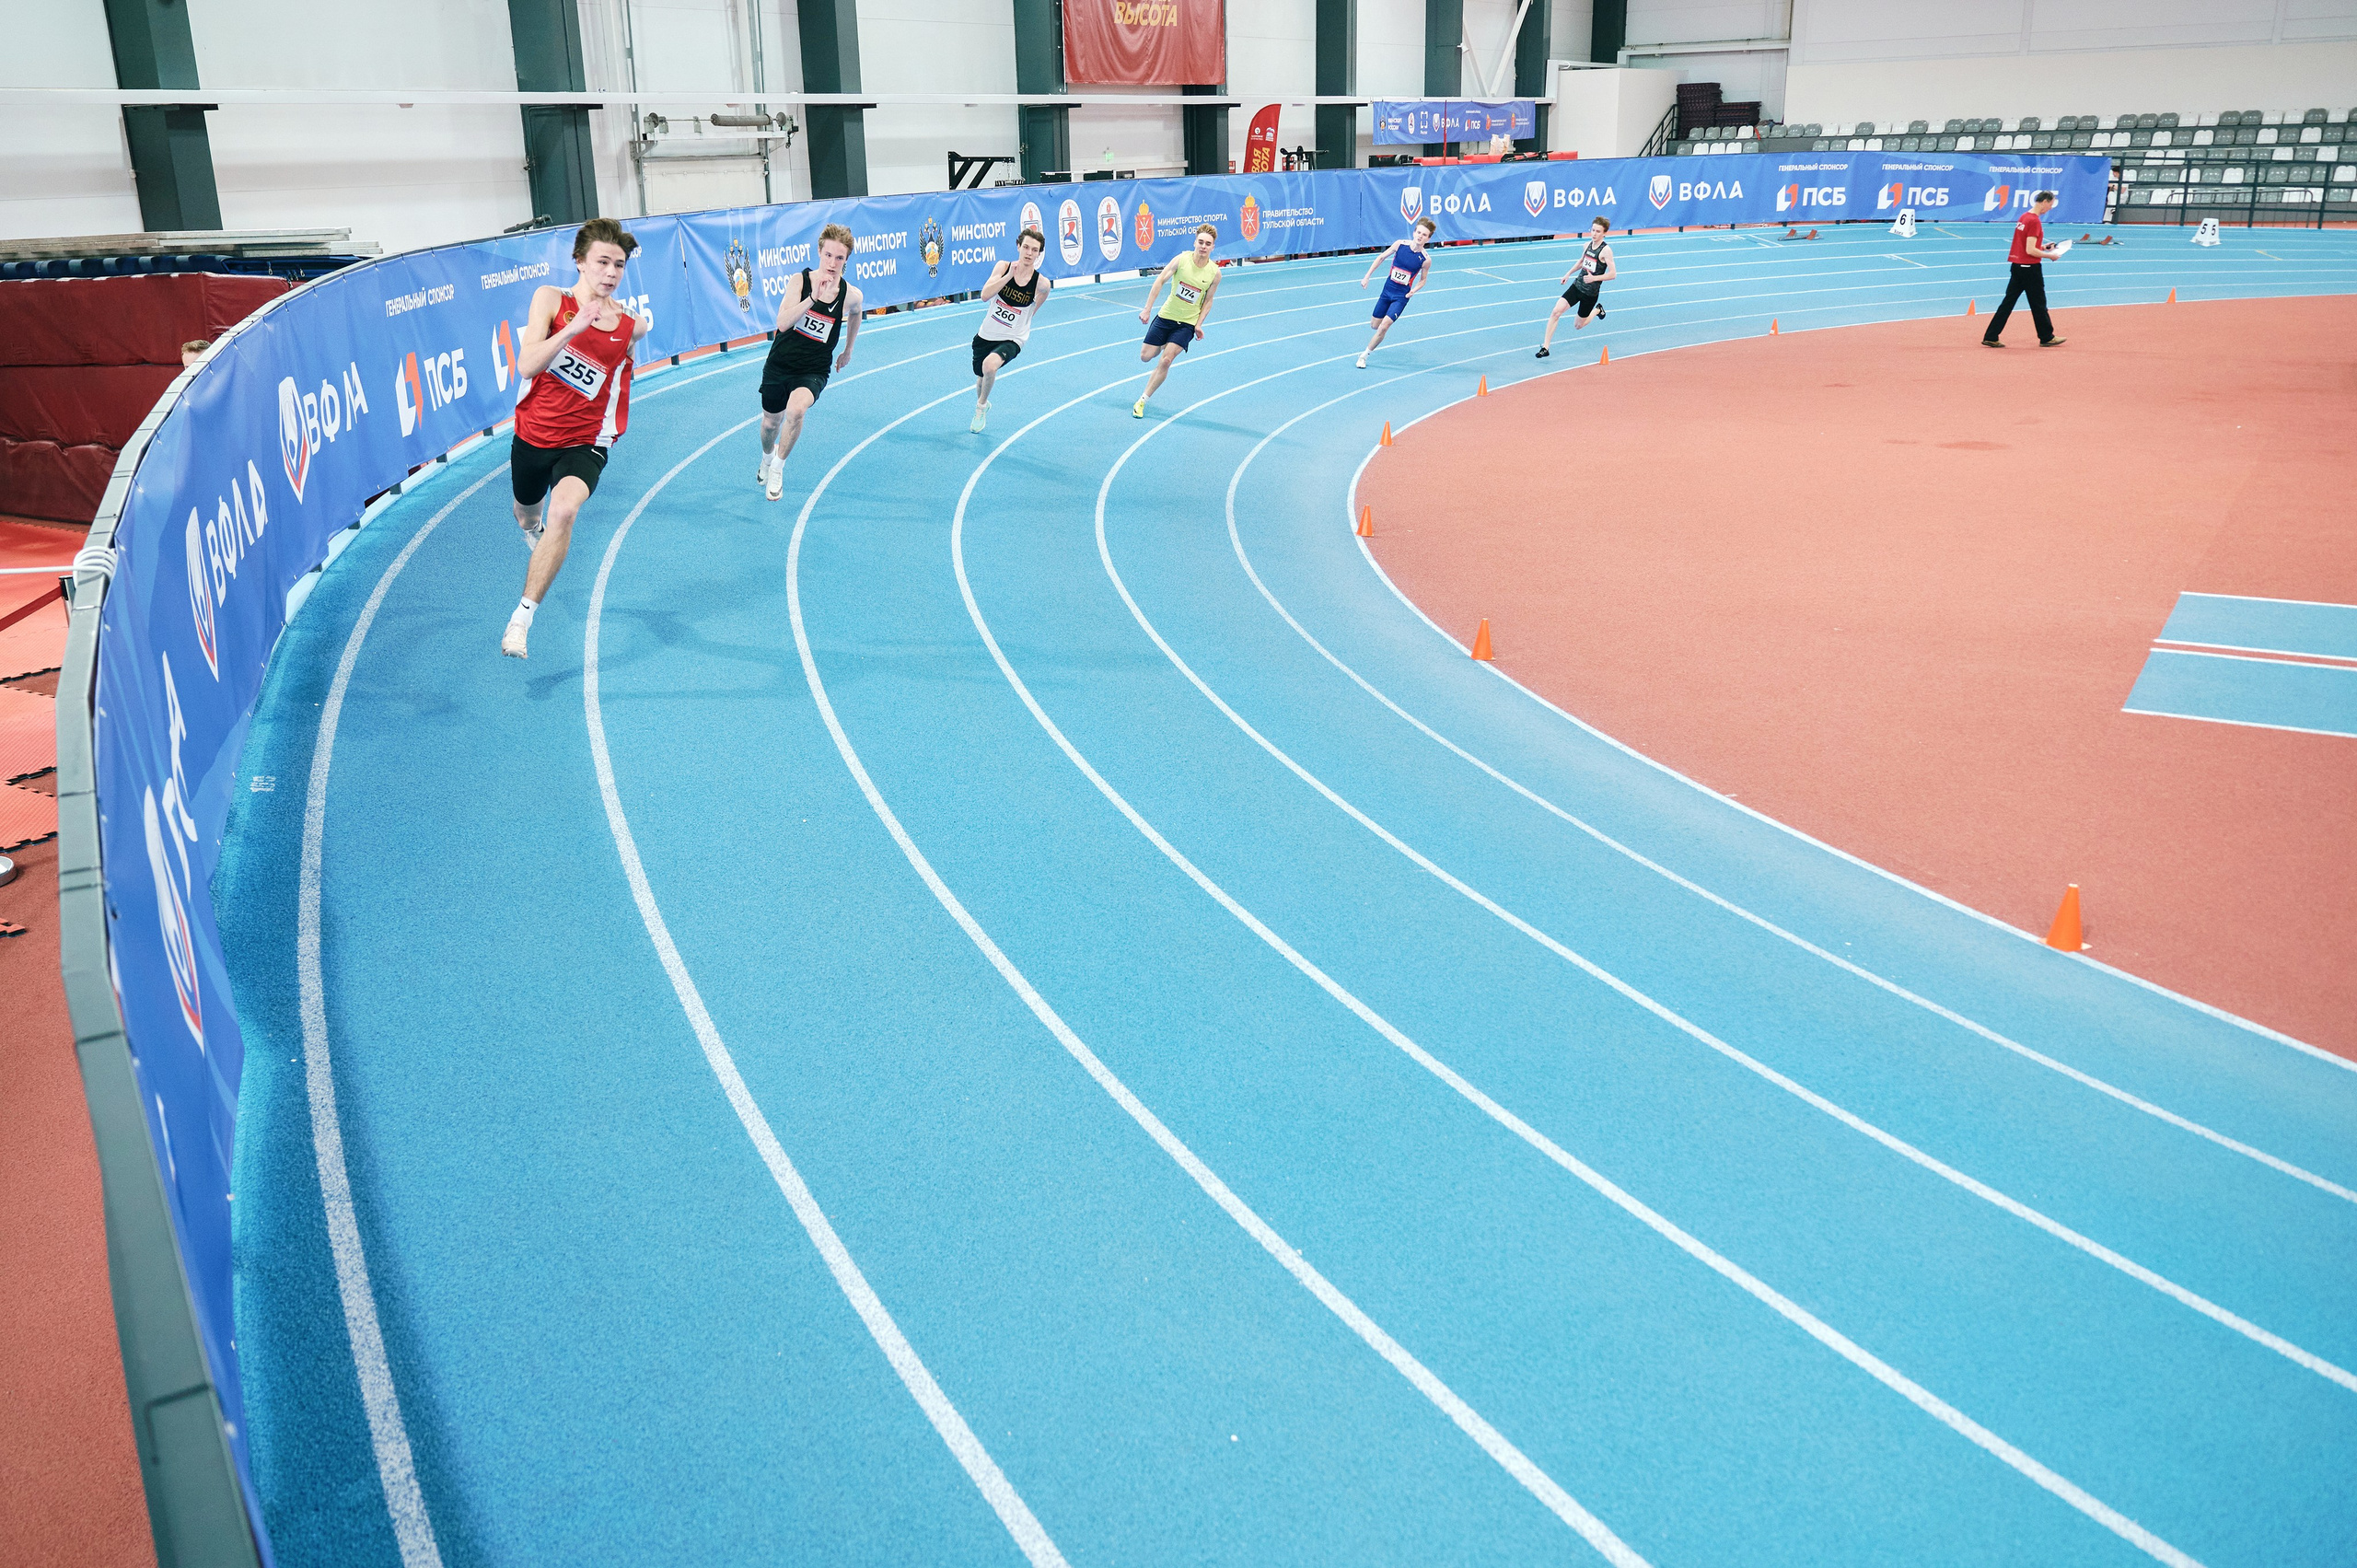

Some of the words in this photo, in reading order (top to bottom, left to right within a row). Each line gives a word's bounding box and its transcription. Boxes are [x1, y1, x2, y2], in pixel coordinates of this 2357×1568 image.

[1114, 2, 1178, 27] ВЫСОТА
[1778, 163, 1817, 171] ГЕНЕРАЛЬНЫЙ
[1882, 163, 1922, 171] ГЕНЕРАЛЬНЫЙ
[1553, 187, 1617, 208] ВФЛА
[1678, 180, 1743, 202] ВФЛА
[1802, 187, 1846, 206] ПСБ
[1907, 187, 1949, 206] ПСБ
[1262, 207, 1314, 218] ПРАВИТЕЛЬСТВО
[1430, 192, 1492, 215] ВФЛА
[1157, 215, 1202, 226] МИНИСТЕРСТВО
[1203, 213, 1227, 223] СПОРТА
[1262, 217, 1295, 229] ТУЛЬСКОЙ
[1296, 217, 1324, 227] ОБЛАСТИ
[1899, 214, 1907, 226] 6
[2200, 223, 2208, 235] 5
[951, 222, 1005, 242] МИНСПОРТ
[1157, 226, 1187, 238] ТУЛЬСКОЙ
[2211, 224, 2216, 236] 5
[853, 231, 908, 254] МИНСПОРТ
[758, 243, 810, 268] МИНСПОРТ
[951, 246, 996, 266] РОССИИ
[481, 264, 518, 290] ГЕНЕРАЛЬНЫЙ
[518, 261, 551, 281] СПОНСОР
[855, 258, 897, 280] РОССИИ
[1394, 271, 1407, 281] 127
[385, 287, 426, 318] ГЕНЕРАЛЬНЫЙ
[427, 284, 455, 306] СПОНСОР
[1002, 285, 1030, 306] RUSSIA
[1180, 286, 1195, 299] 174
[995, 307, 1016, 321] 260
[804, 316, 825, 334] 152
[424, 347, 468, 412] ПСБ
[559, 355, 598, 386] 255
[303, 361, 369, 456] ВФЛА
[205, 459, 269, 609] ВФЛА
